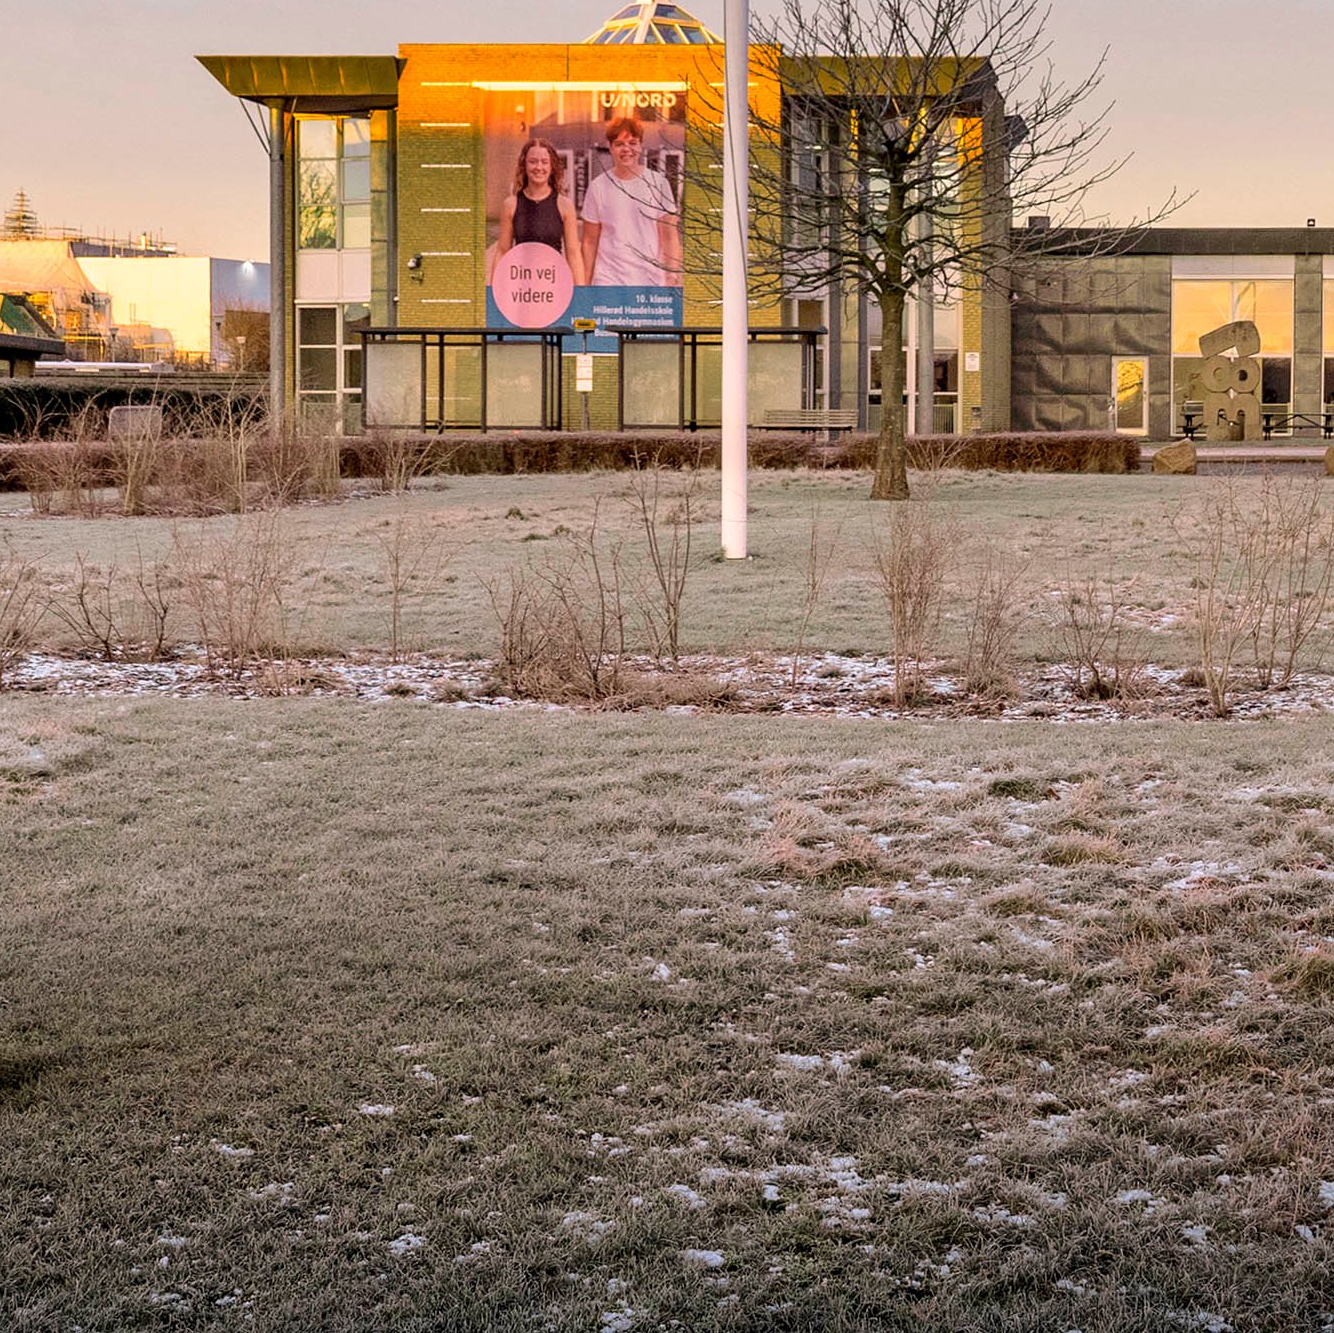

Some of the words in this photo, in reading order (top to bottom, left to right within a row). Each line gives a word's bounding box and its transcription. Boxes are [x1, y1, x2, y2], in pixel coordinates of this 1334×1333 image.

[601, 93, 677, 108] U/NORD
[510, 265, 532, 280] Din
[537, 265, 556, 283] vej
[511, 288, 554, 303] videre
[636, 294, 648, 303] 10.
